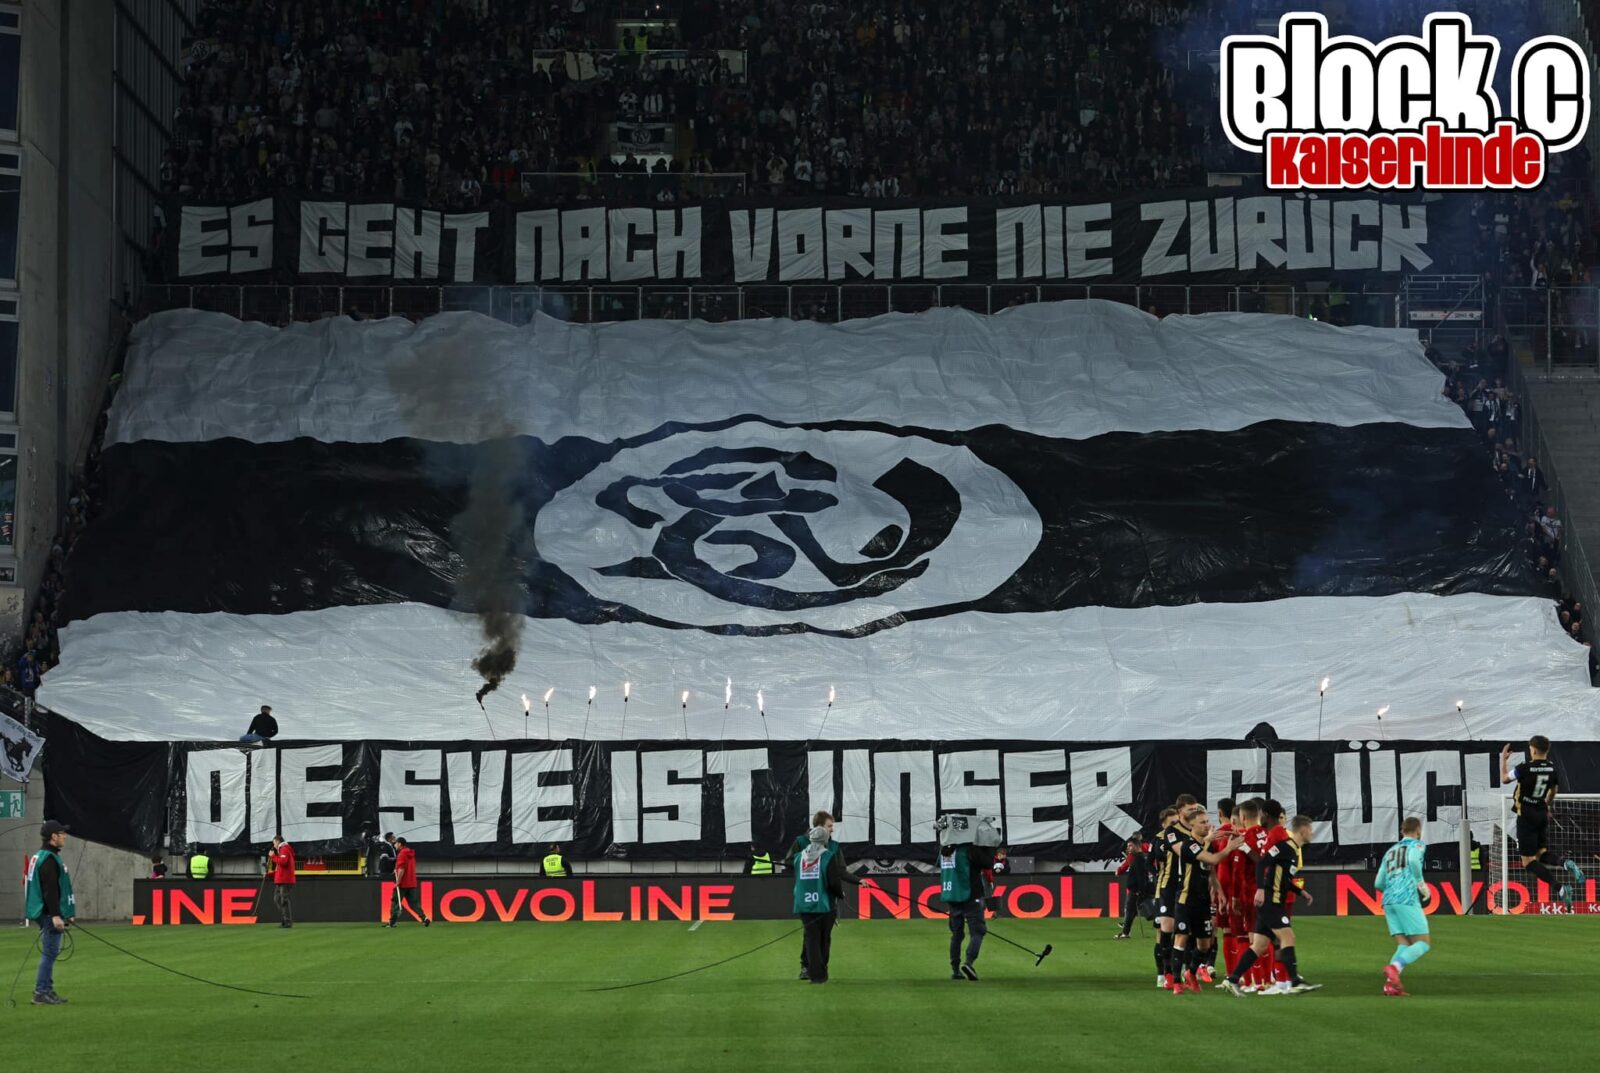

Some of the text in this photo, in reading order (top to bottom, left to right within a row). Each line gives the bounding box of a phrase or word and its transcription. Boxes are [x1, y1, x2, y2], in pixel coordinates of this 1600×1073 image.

[178, 192, 1433, 283] ES GEHT NACH VORNE NIE ZURÜCK
[186, 744, 343, 843] DIE
[379, 748, 574, 845] SVE
[611, 747, 769, 845] IST
[808, 746, 1143, 845] UNSER
[1532, 774, 1550, 798] 6
[804, 891, 819, 903] 20
[943, 881, 953, 892] 18
[133, 889, 258, 926] INE
